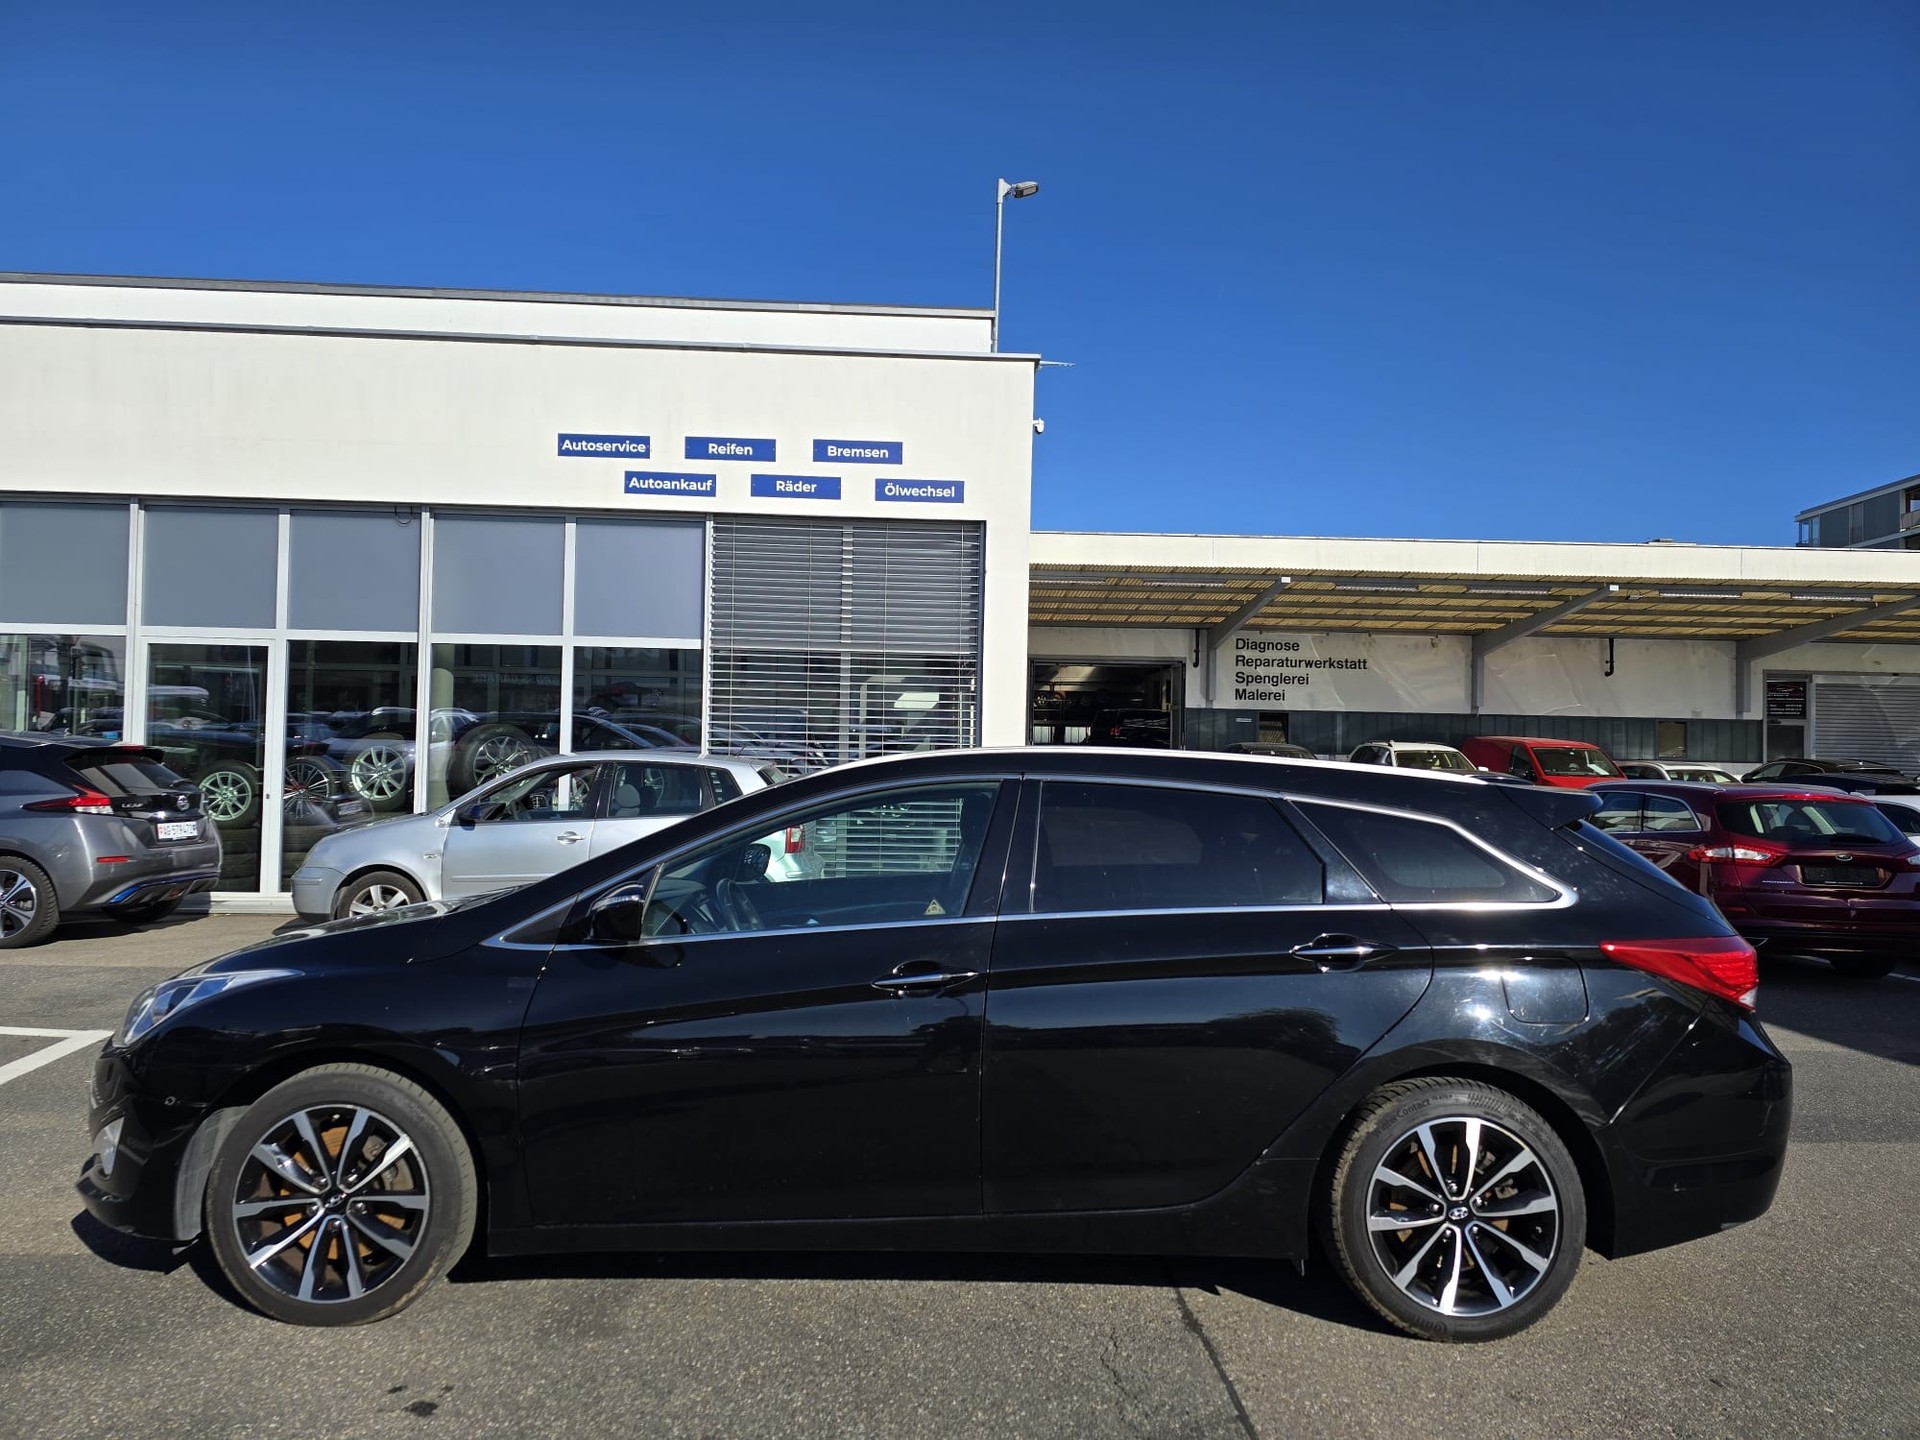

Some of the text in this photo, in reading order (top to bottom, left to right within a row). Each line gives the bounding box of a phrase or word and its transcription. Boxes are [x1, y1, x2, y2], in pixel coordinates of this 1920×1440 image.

[561, 439, 647, 454] Autoservice
[707, 442, 753, 456] Reifen
[827, 445, 890, 459] Bremsen
[628, 476, 713, 492] Autoankauf
[775, 479, 817, 493] Räder
[884, 482, 956, 499] Ölwechsel
[1235, 638, 1300, 653] Diagnose
[1235, 655, 1368, 670] Reparaturwerkstatt
[1235, 672, 1310, 687] Spenglerei
[1235, 688, 1286, 701] Malerei
